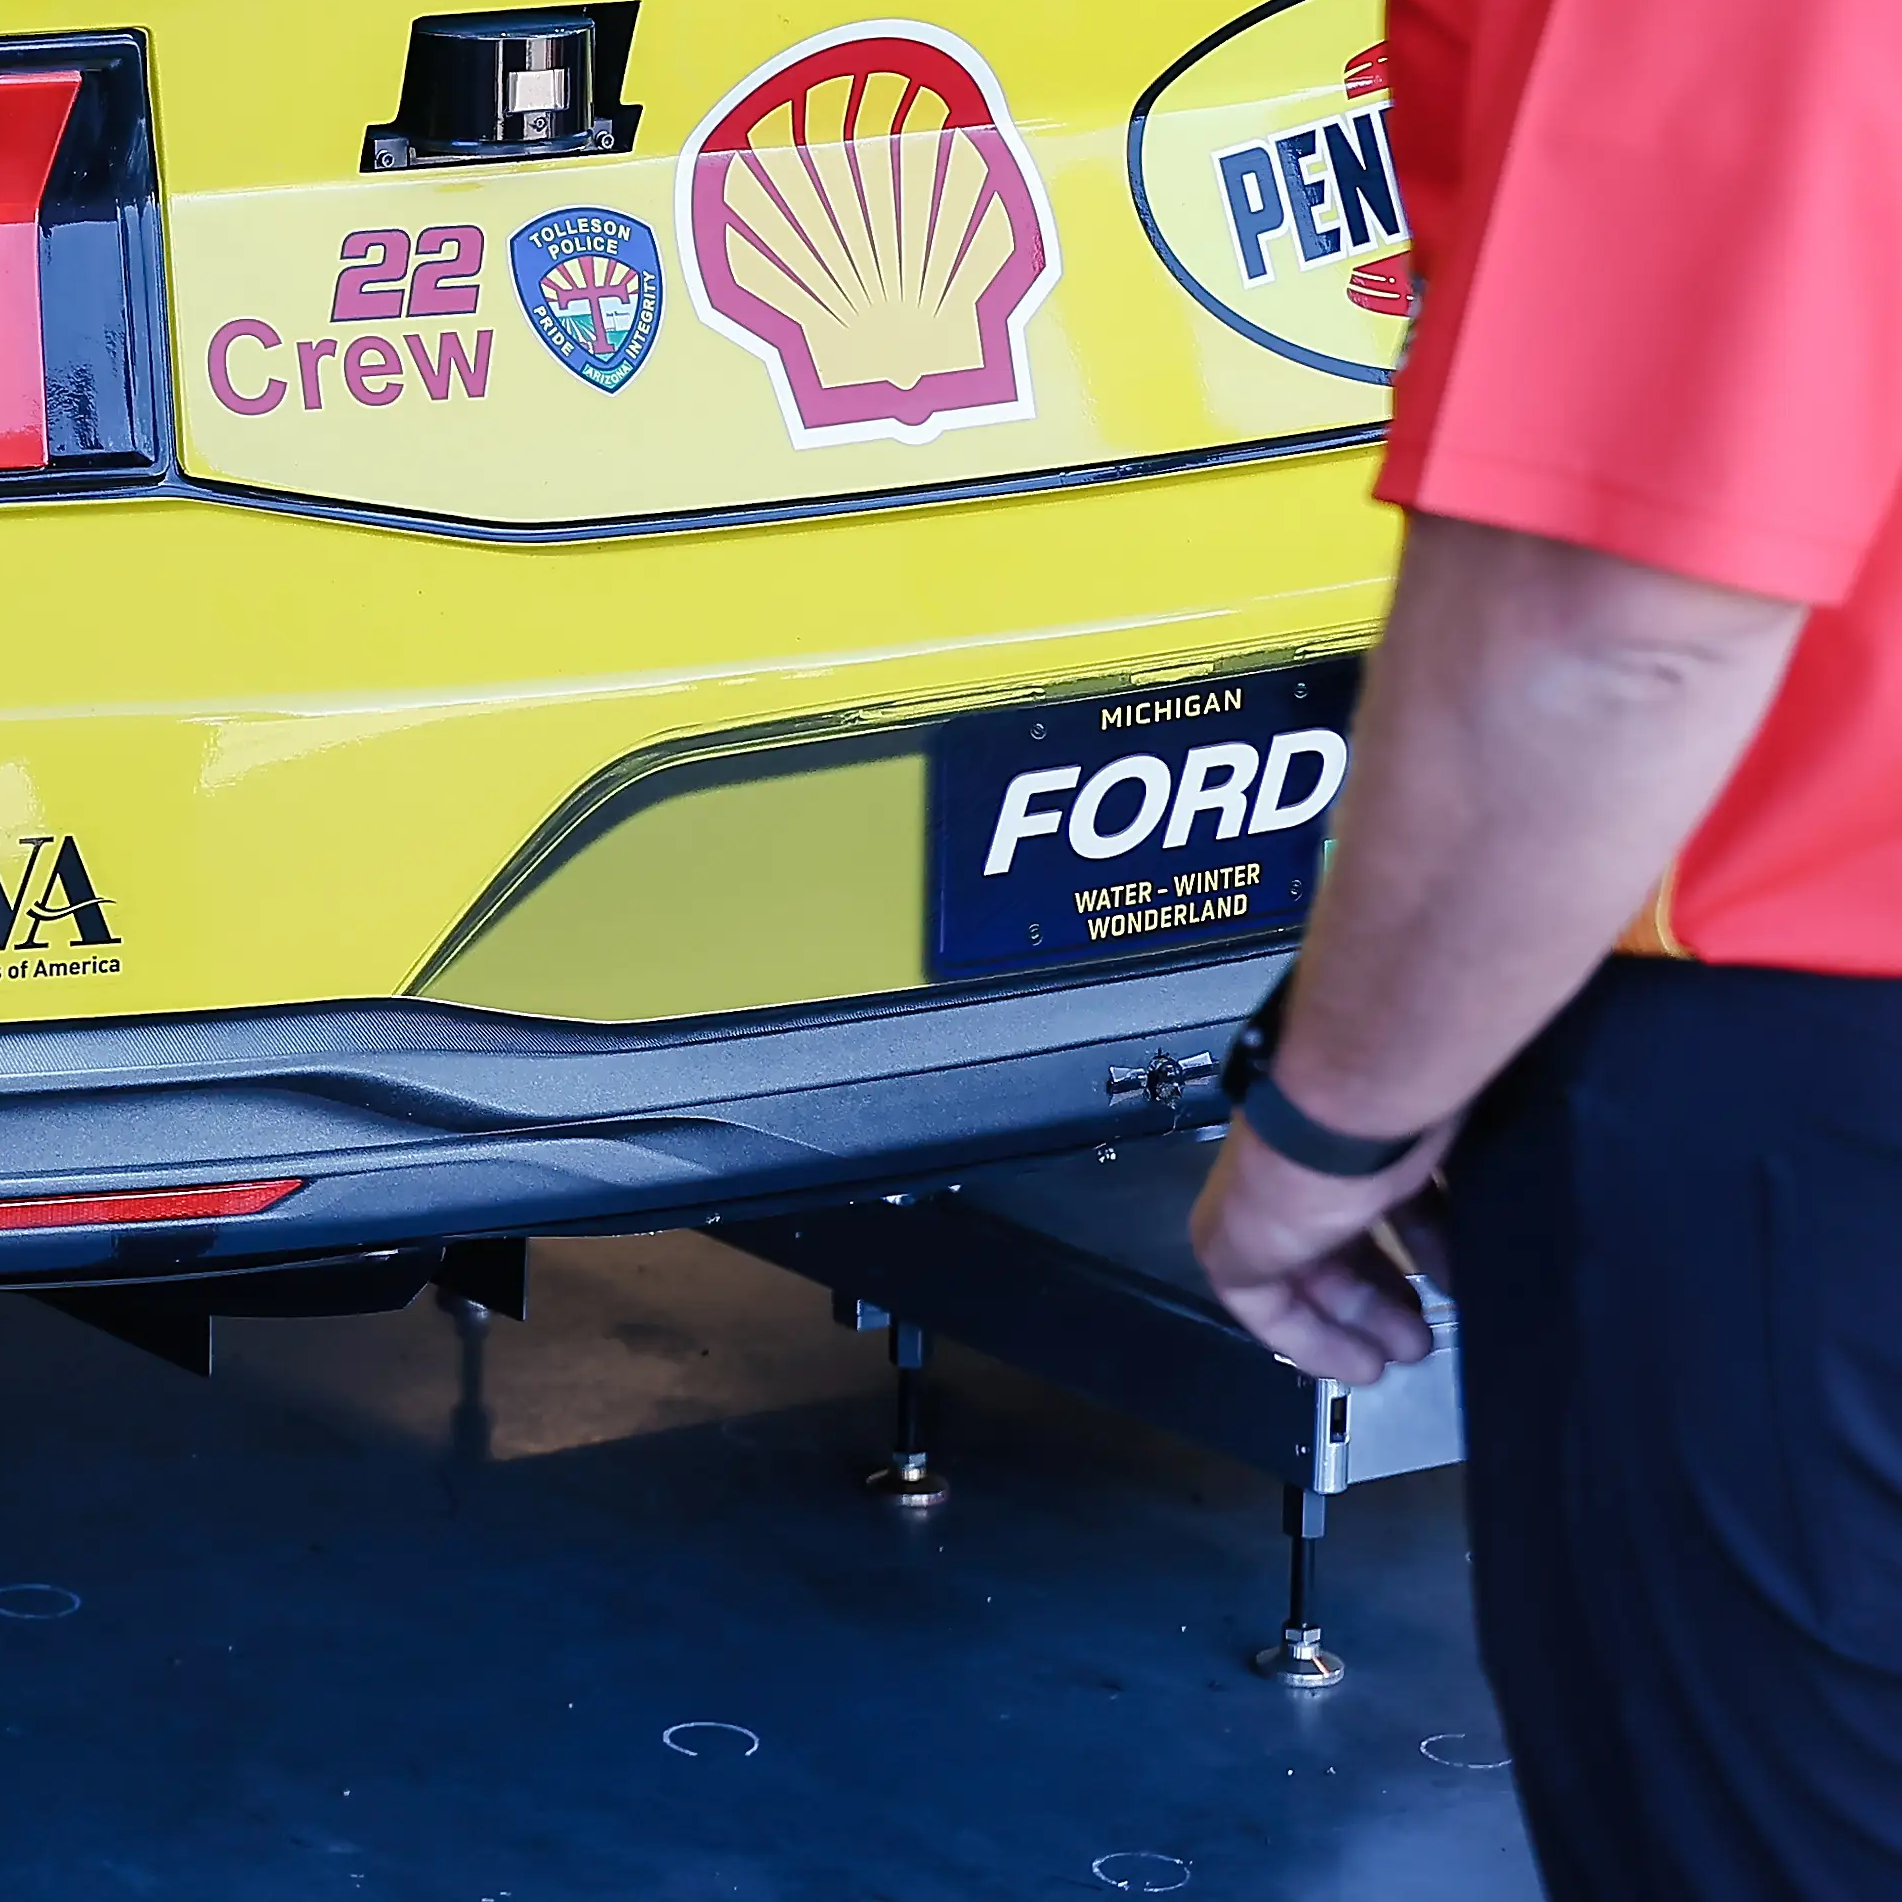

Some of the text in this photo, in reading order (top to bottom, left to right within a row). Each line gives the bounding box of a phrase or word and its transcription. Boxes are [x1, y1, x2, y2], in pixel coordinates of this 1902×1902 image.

[529, 217, 632, 249] TOLLESON
[547, 235, 619, 261] POLICE
[331, 224, 485, 323] 22
[533, 304, 575, 358] PRIDE
[624, 270, 657, 360] INTEGRITY
[207, 318, 496, 418] Crew
[584, 360, 634, 385] ARIZONA
[1099, 688, 1244, 732] MICHIGAN
[982, 726, 1350, 877] FORD
[1074, 881, 1153, 915] WATER
[1172, 862, 1262, 897] WINTER
[1086, 893, 1250, 941] WONDERLAND
[7, 960, 29, 980] of
[33, 956, 122, 979] America
